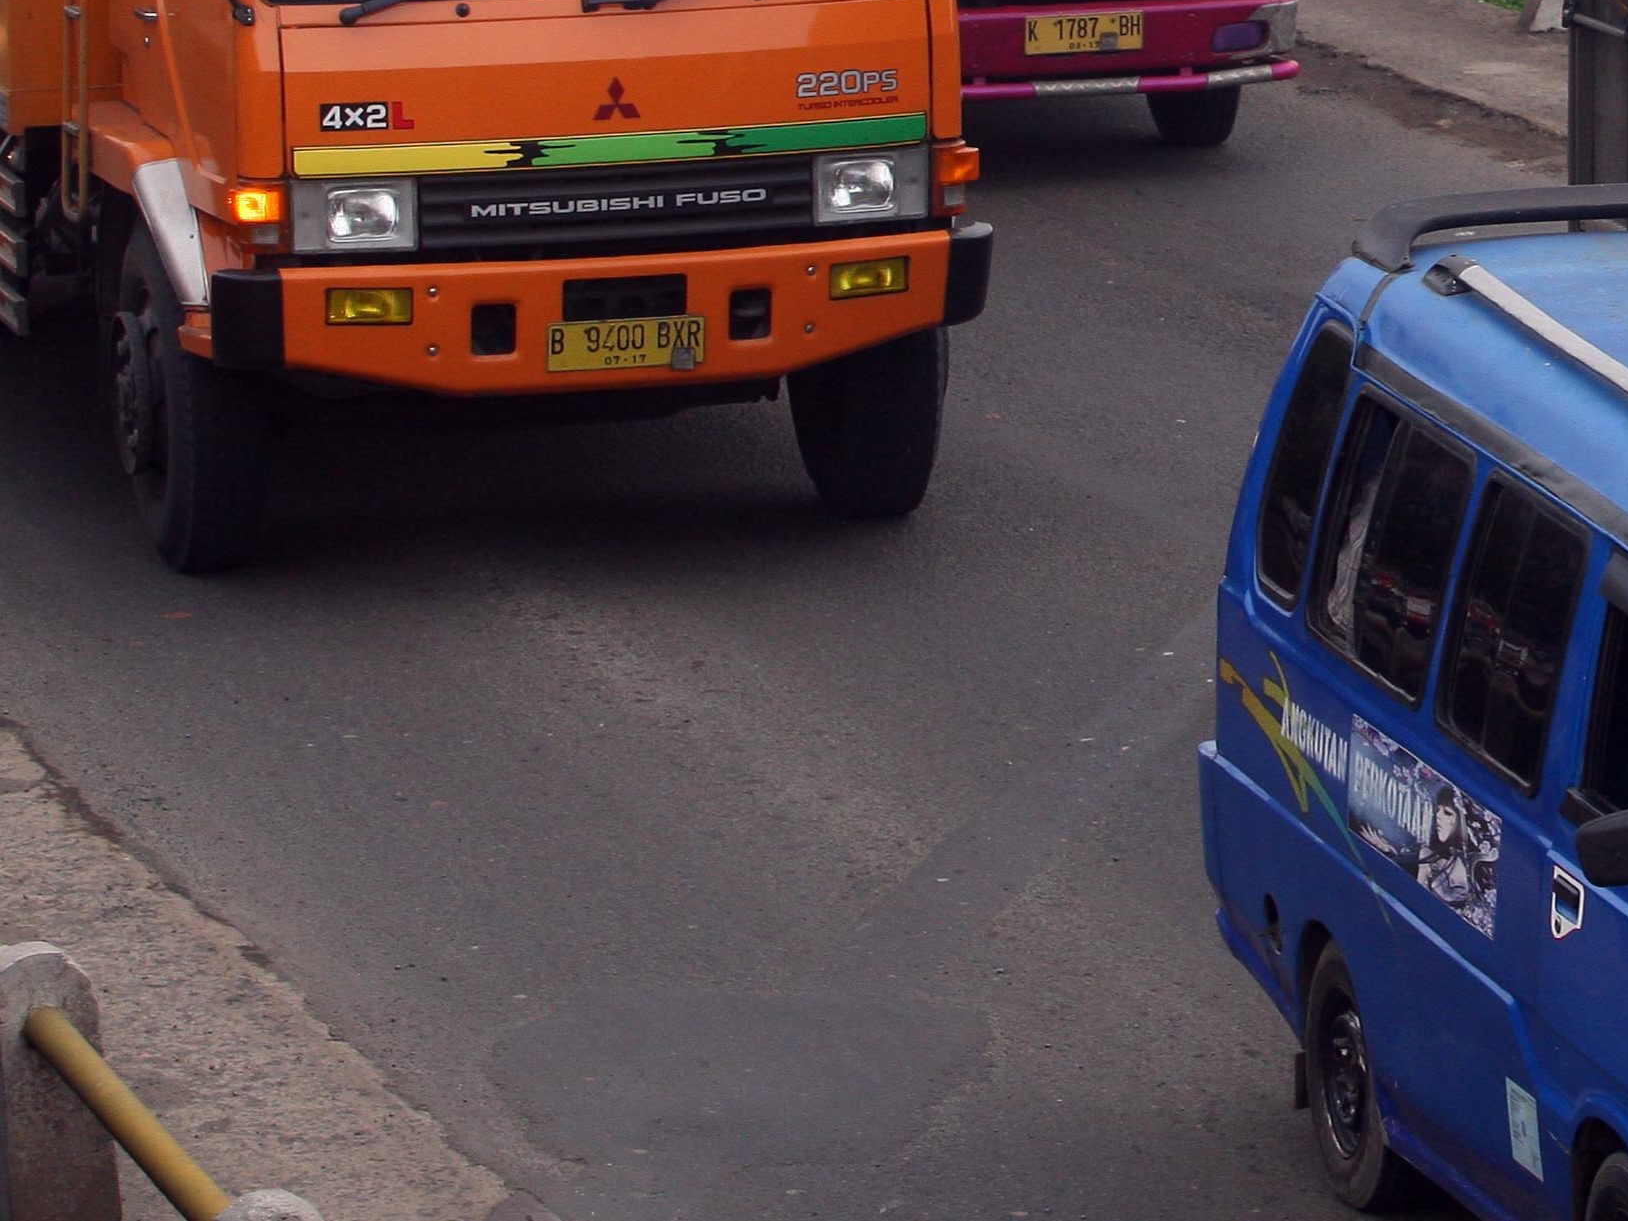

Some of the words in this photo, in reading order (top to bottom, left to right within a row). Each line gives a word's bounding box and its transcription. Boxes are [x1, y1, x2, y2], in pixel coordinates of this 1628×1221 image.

[1027, 20, 1038, 42] K
[1056, 17, 1099, 40] 1787
[1119, 15, 1140, 36] BH
[796, 69, 899, 98] 220PS
[471, 195, 664, 218] MITSUBISHI
[676, 188, 767, 205] FUSO
[551, 328, 564, 355] B
[584, 324, 645, 353] 9400
[657, 321, 700, 349] BXR
